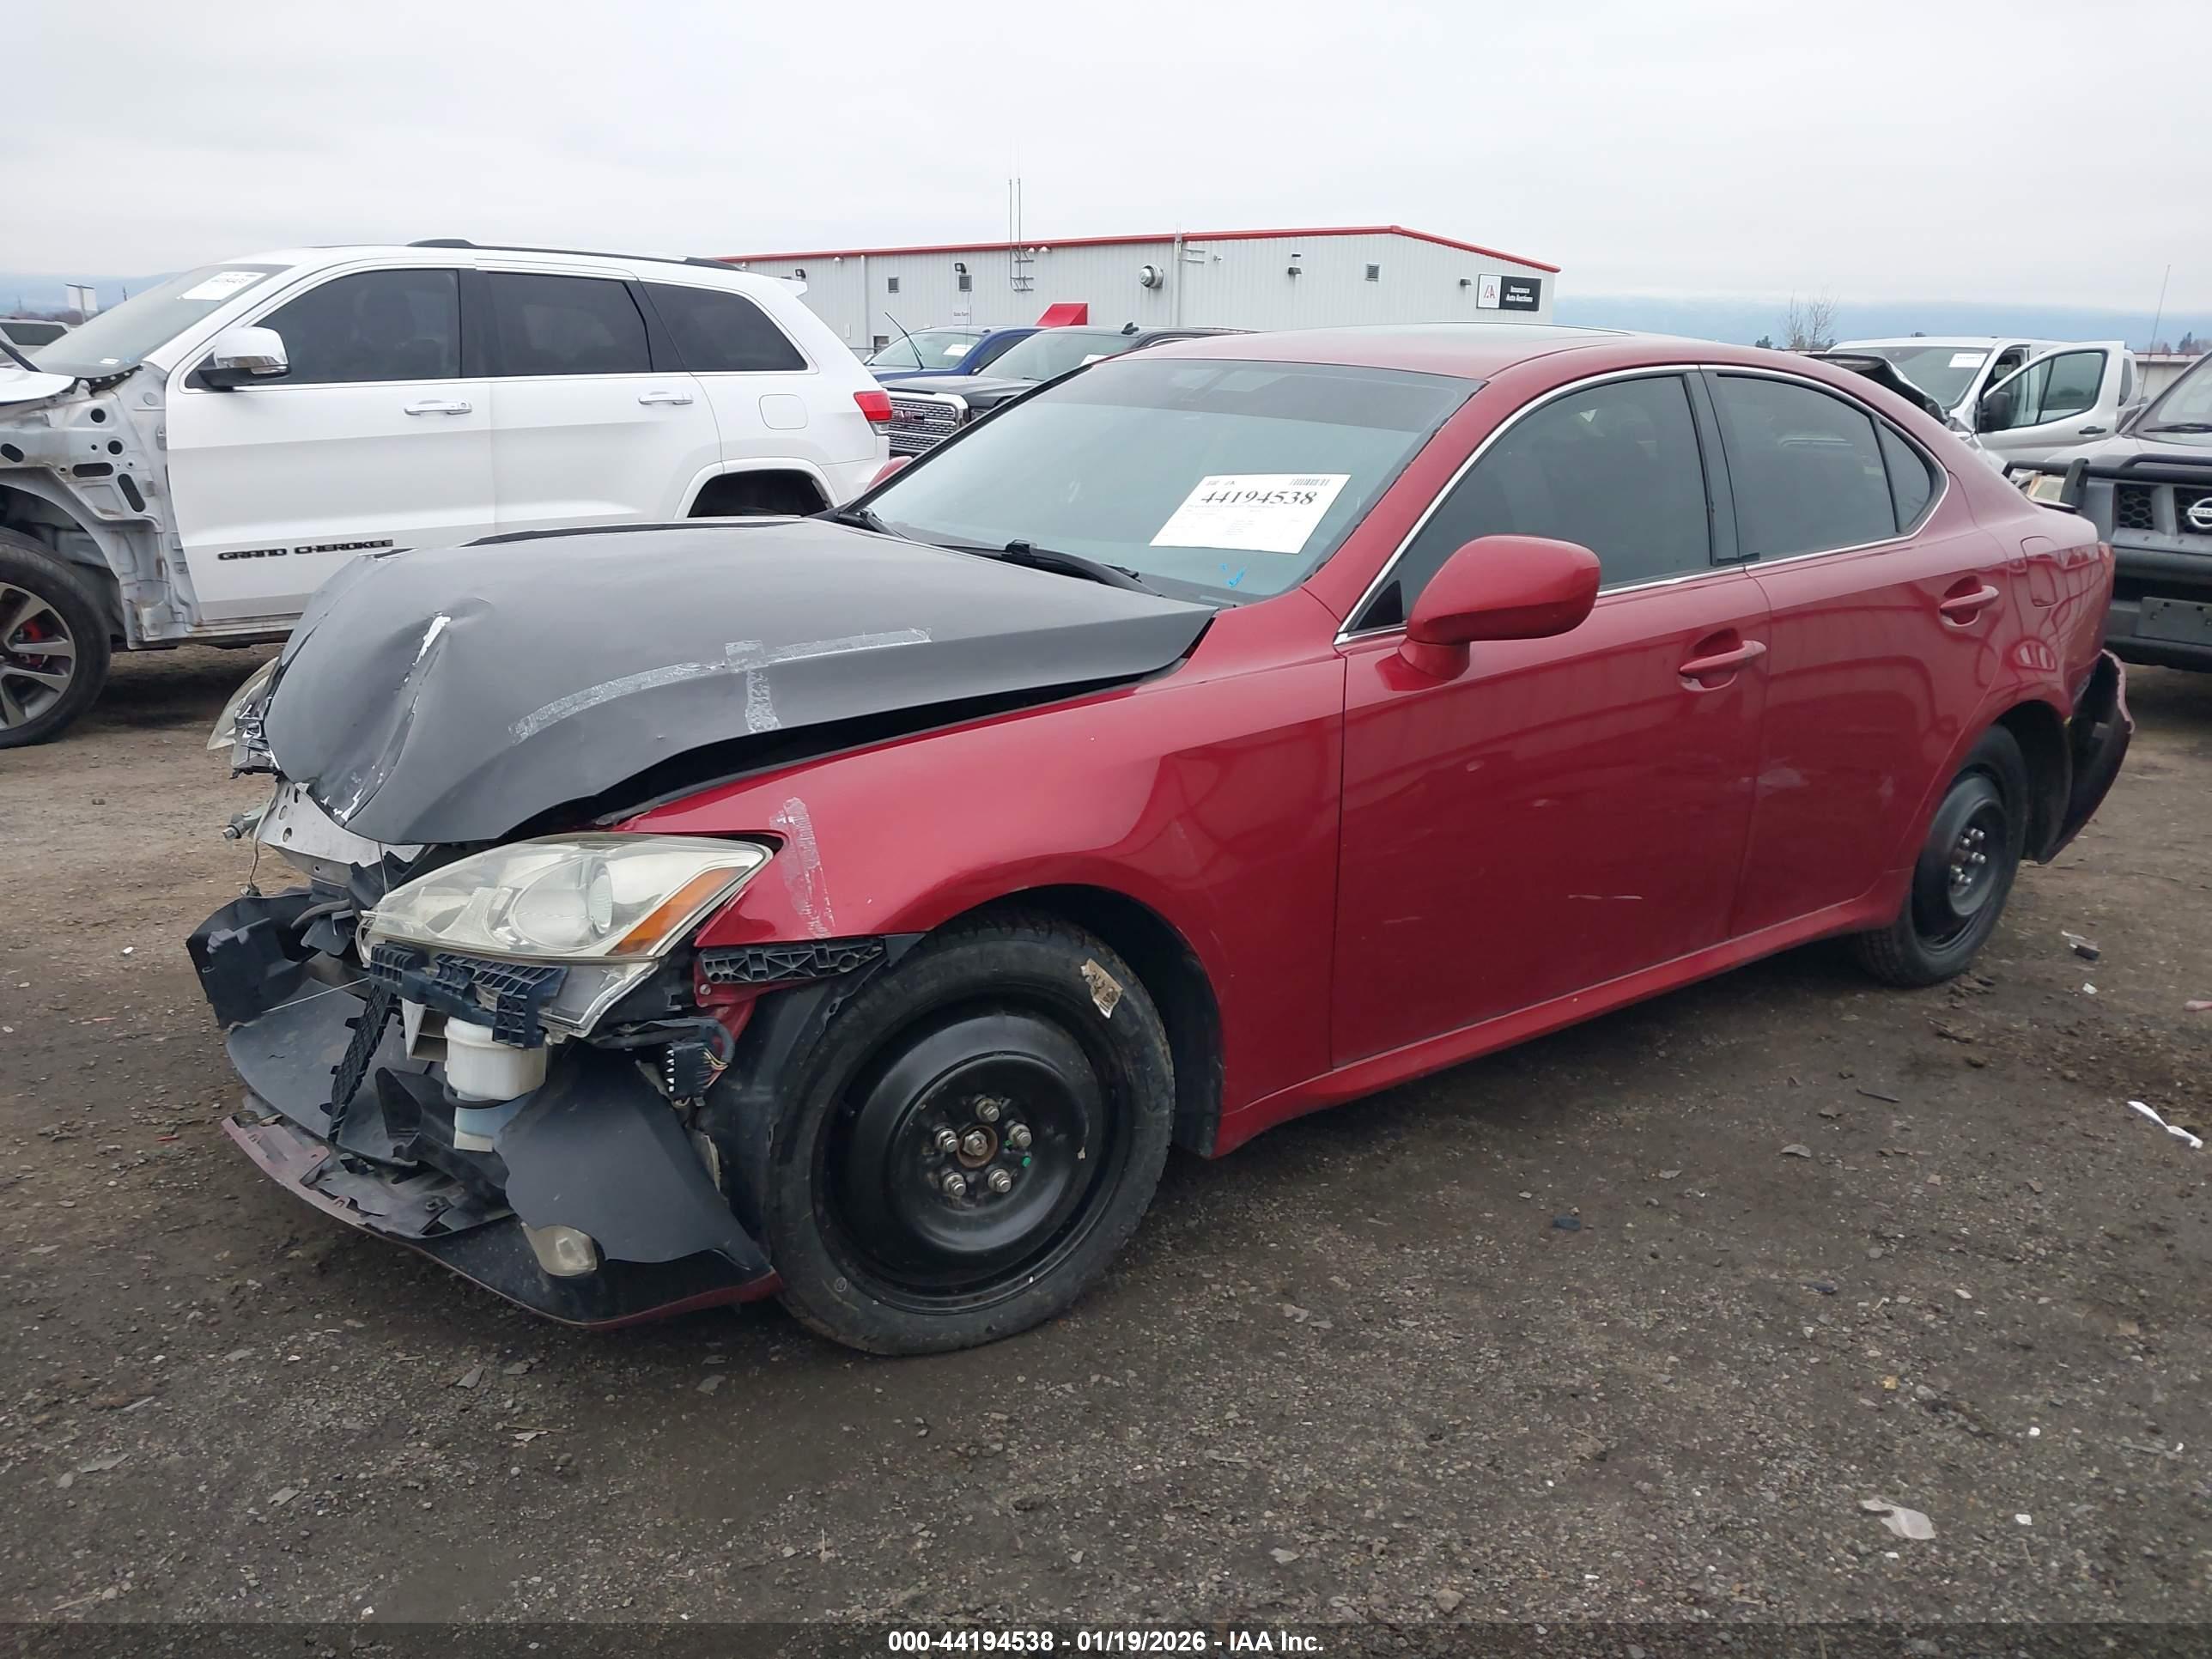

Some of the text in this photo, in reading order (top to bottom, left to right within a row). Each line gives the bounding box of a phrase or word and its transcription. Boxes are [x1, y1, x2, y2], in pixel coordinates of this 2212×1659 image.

[1200, 489, 1318, 505] 44194538
[217, 538, 394, 561] GRAND CHEROKEE
